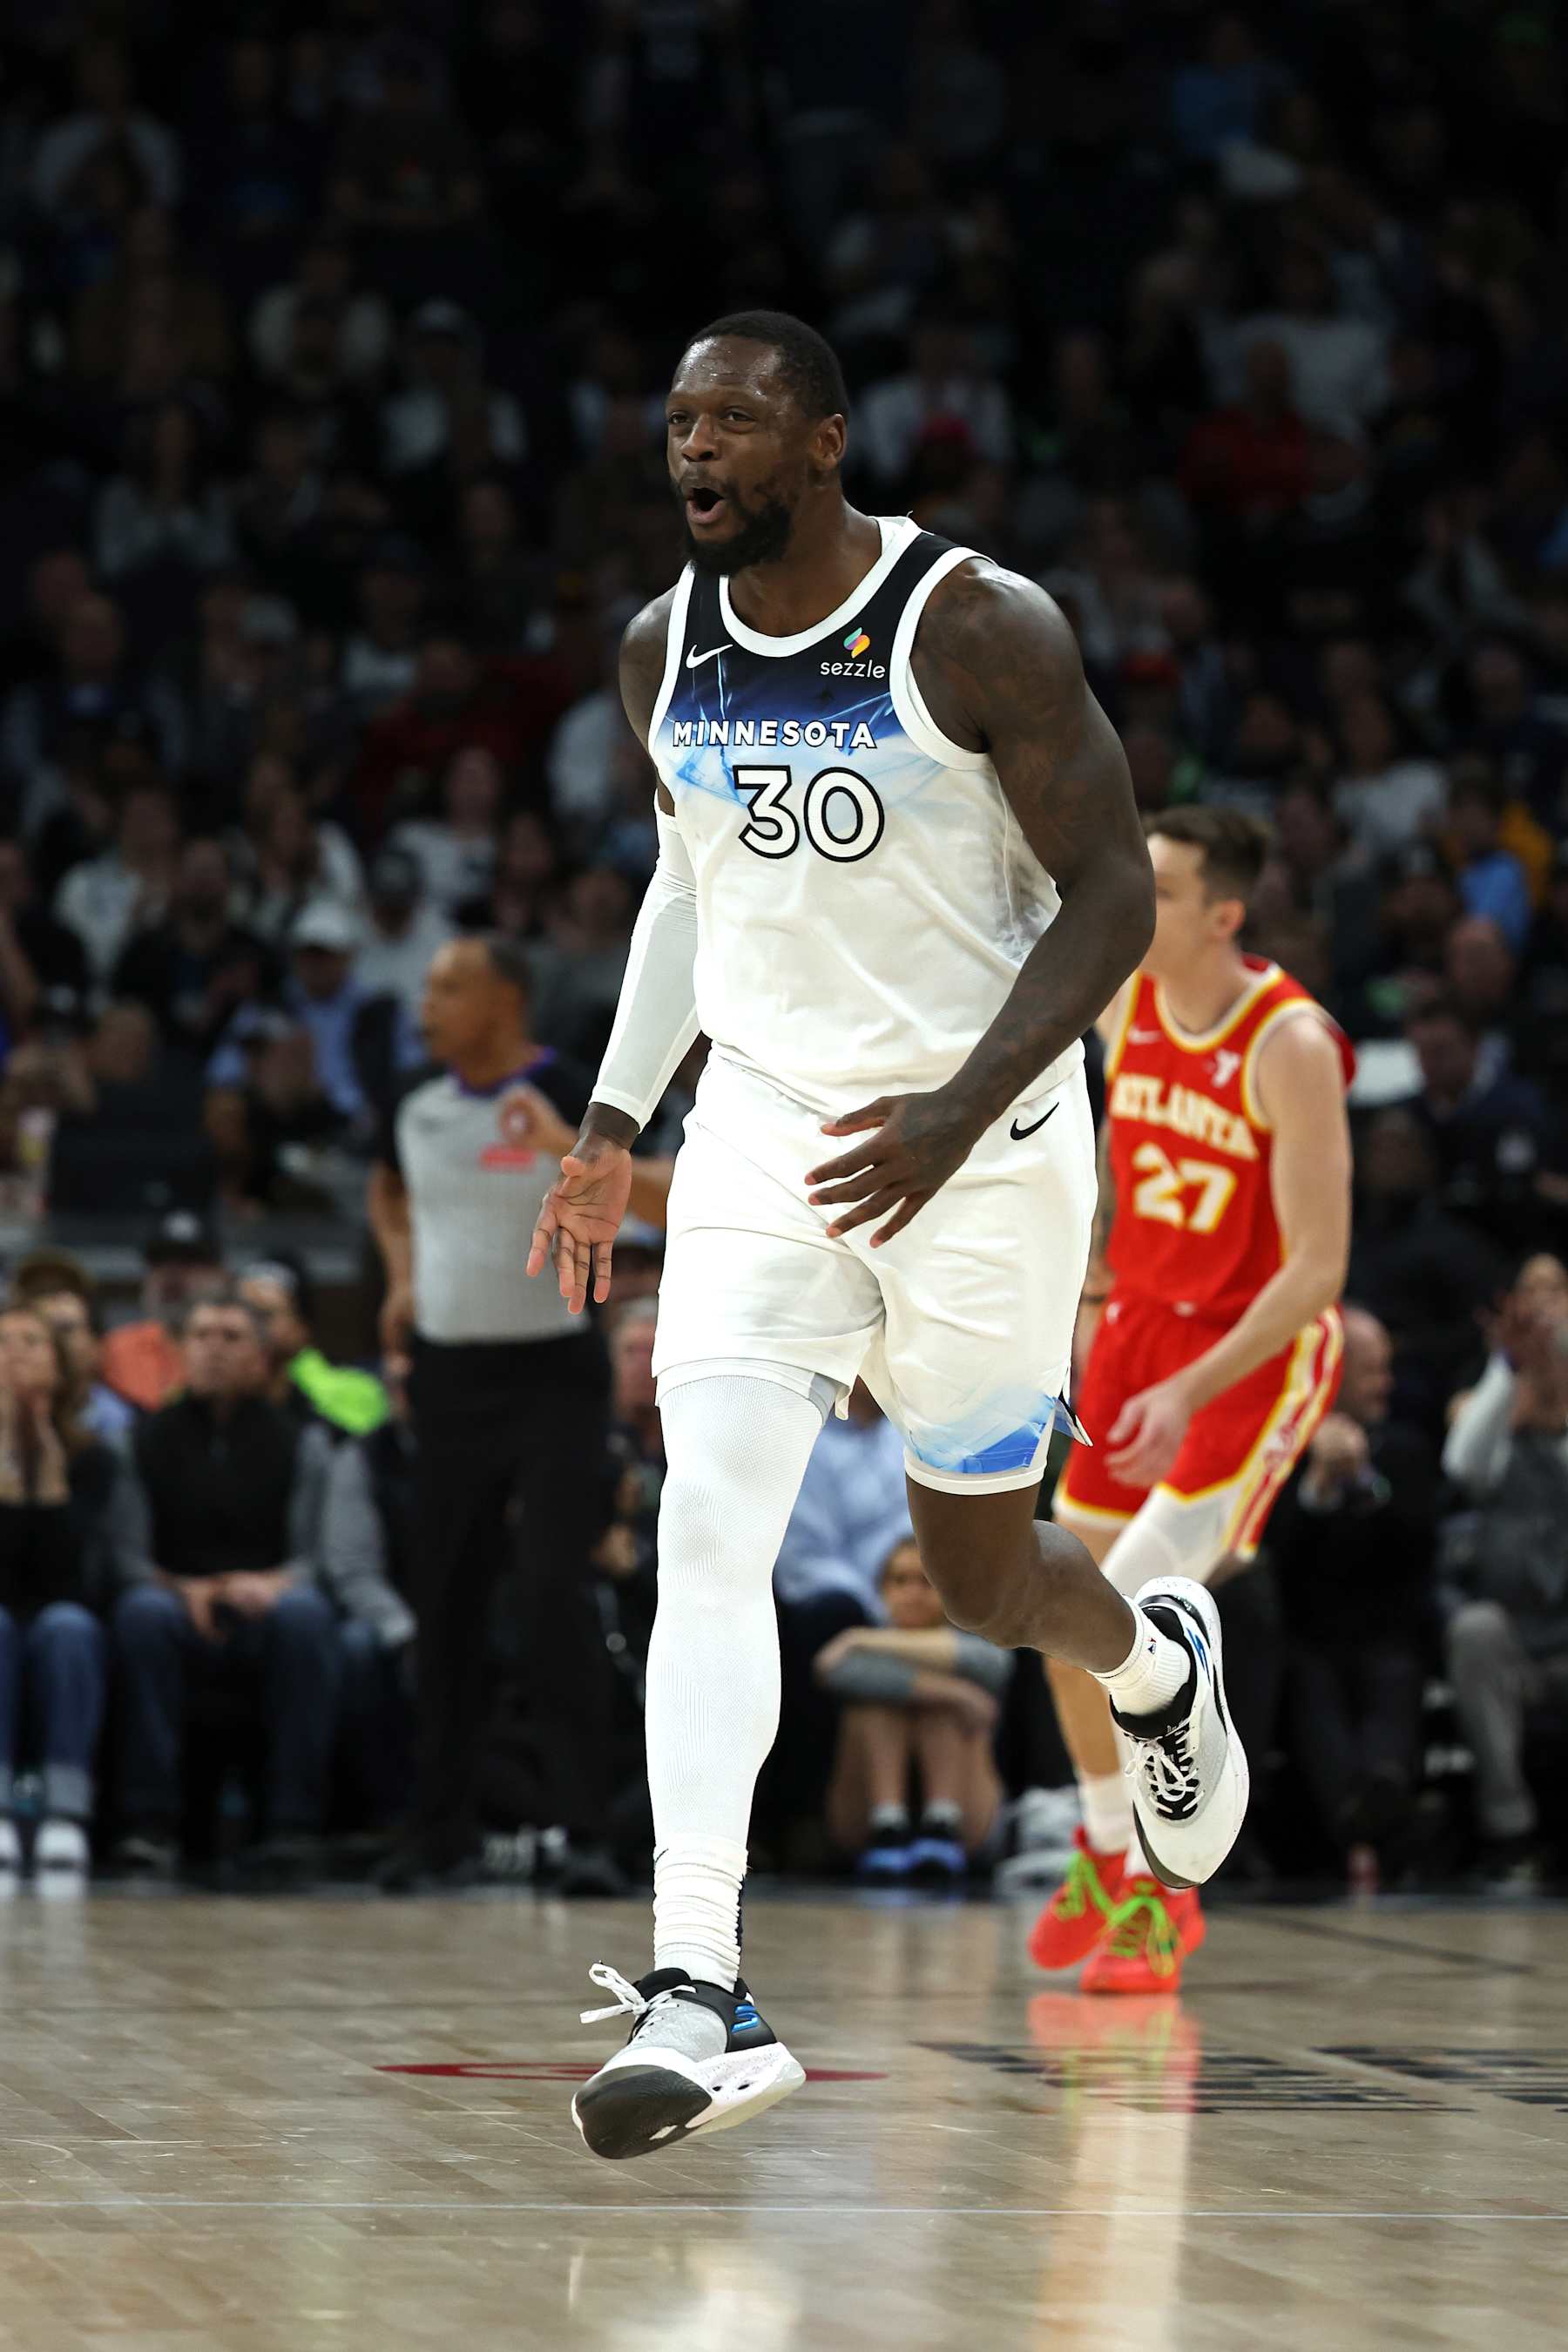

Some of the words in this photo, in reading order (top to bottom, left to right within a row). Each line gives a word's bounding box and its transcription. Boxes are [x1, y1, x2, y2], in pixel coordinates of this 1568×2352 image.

[820, 659, 885, 679] sezzle
[672, 720, 877, 749] MINNESOTA
[733, 765, 885, 862] 30
[1110, 1073, 1260, 1162] ATLANTA
[1133, 1143, 1237, 1234] 27
